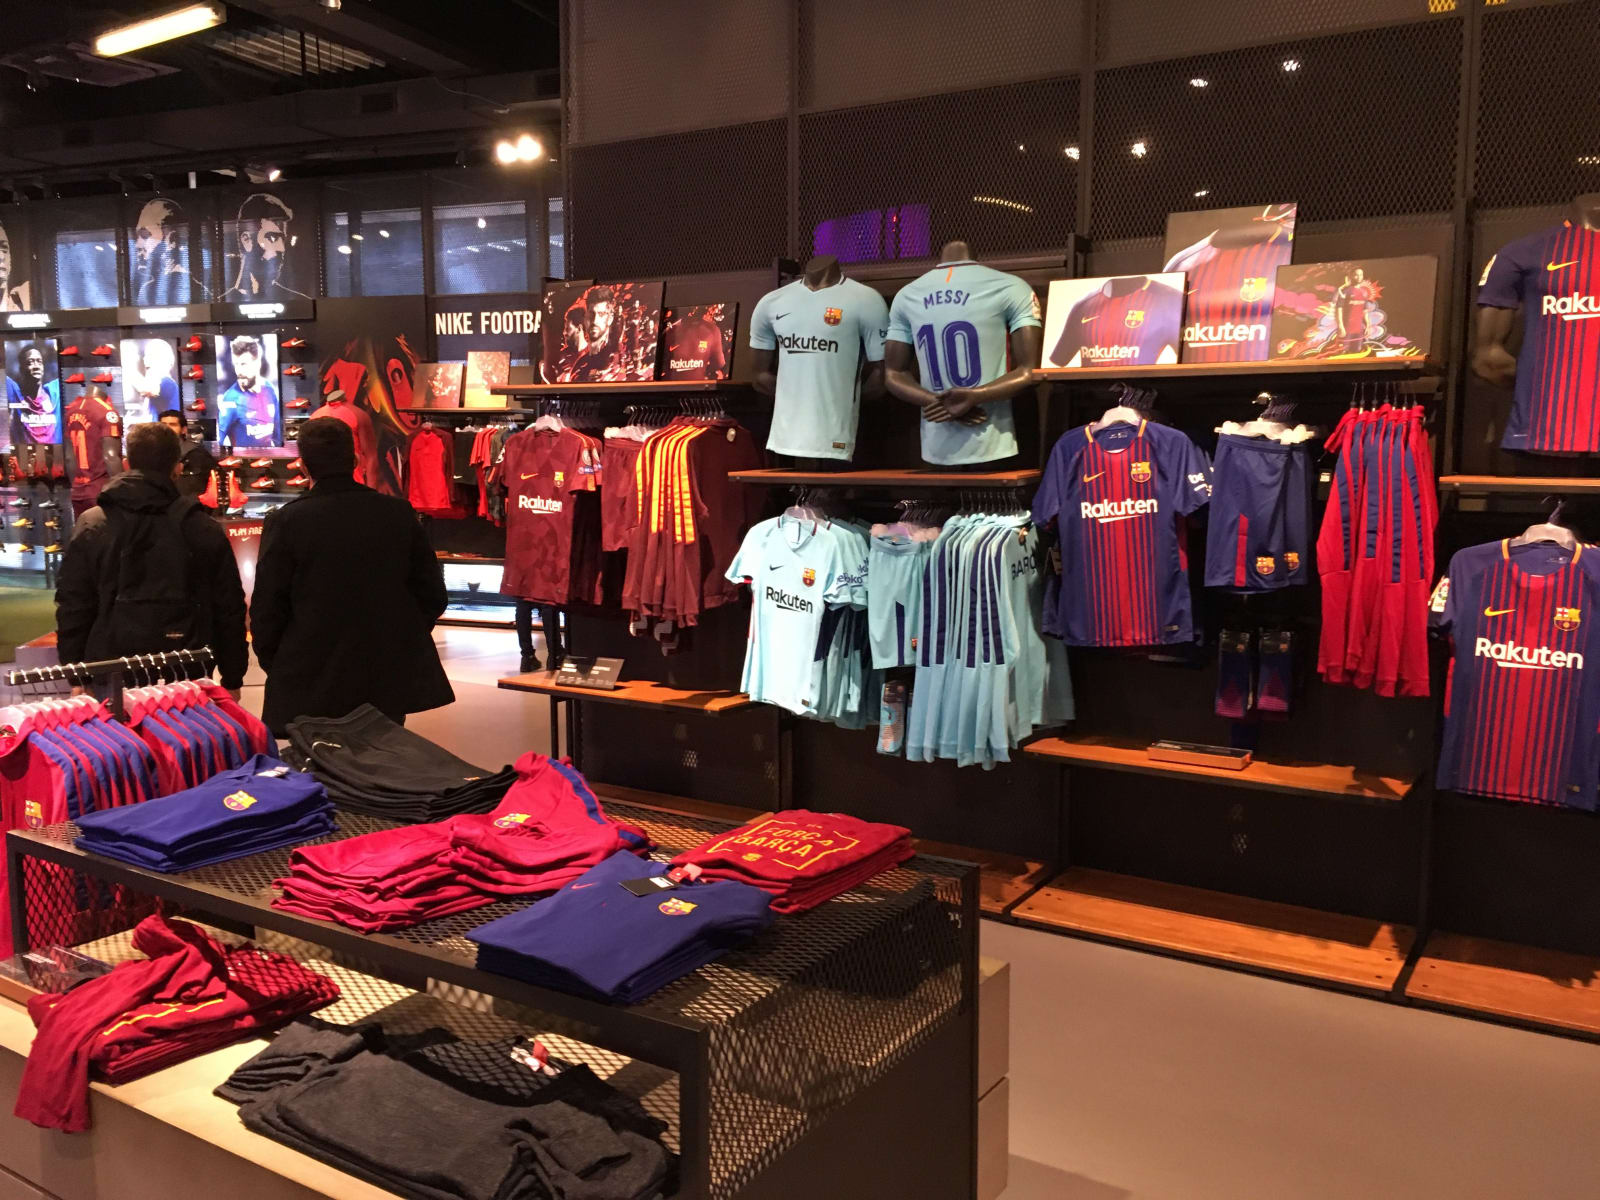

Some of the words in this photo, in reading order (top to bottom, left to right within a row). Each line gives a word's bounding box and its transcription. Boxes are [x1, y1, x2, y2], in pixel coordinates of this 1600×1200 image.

[923, 289, 970, 309] MESSI
[435, 312, 474, 335] NIKE
[1183, 322, 1266, 342] akuten
[917, 320, 982, 391] 10
[1081, 345, 1140, 359] Rakuten
[670, 358, 704, 369] Rakuten
[1080, 498, 1158, 519] Rakuten
[766, 586, 814, 614] Rakuten
[1475, 637, 1583, 670] Rakuten
